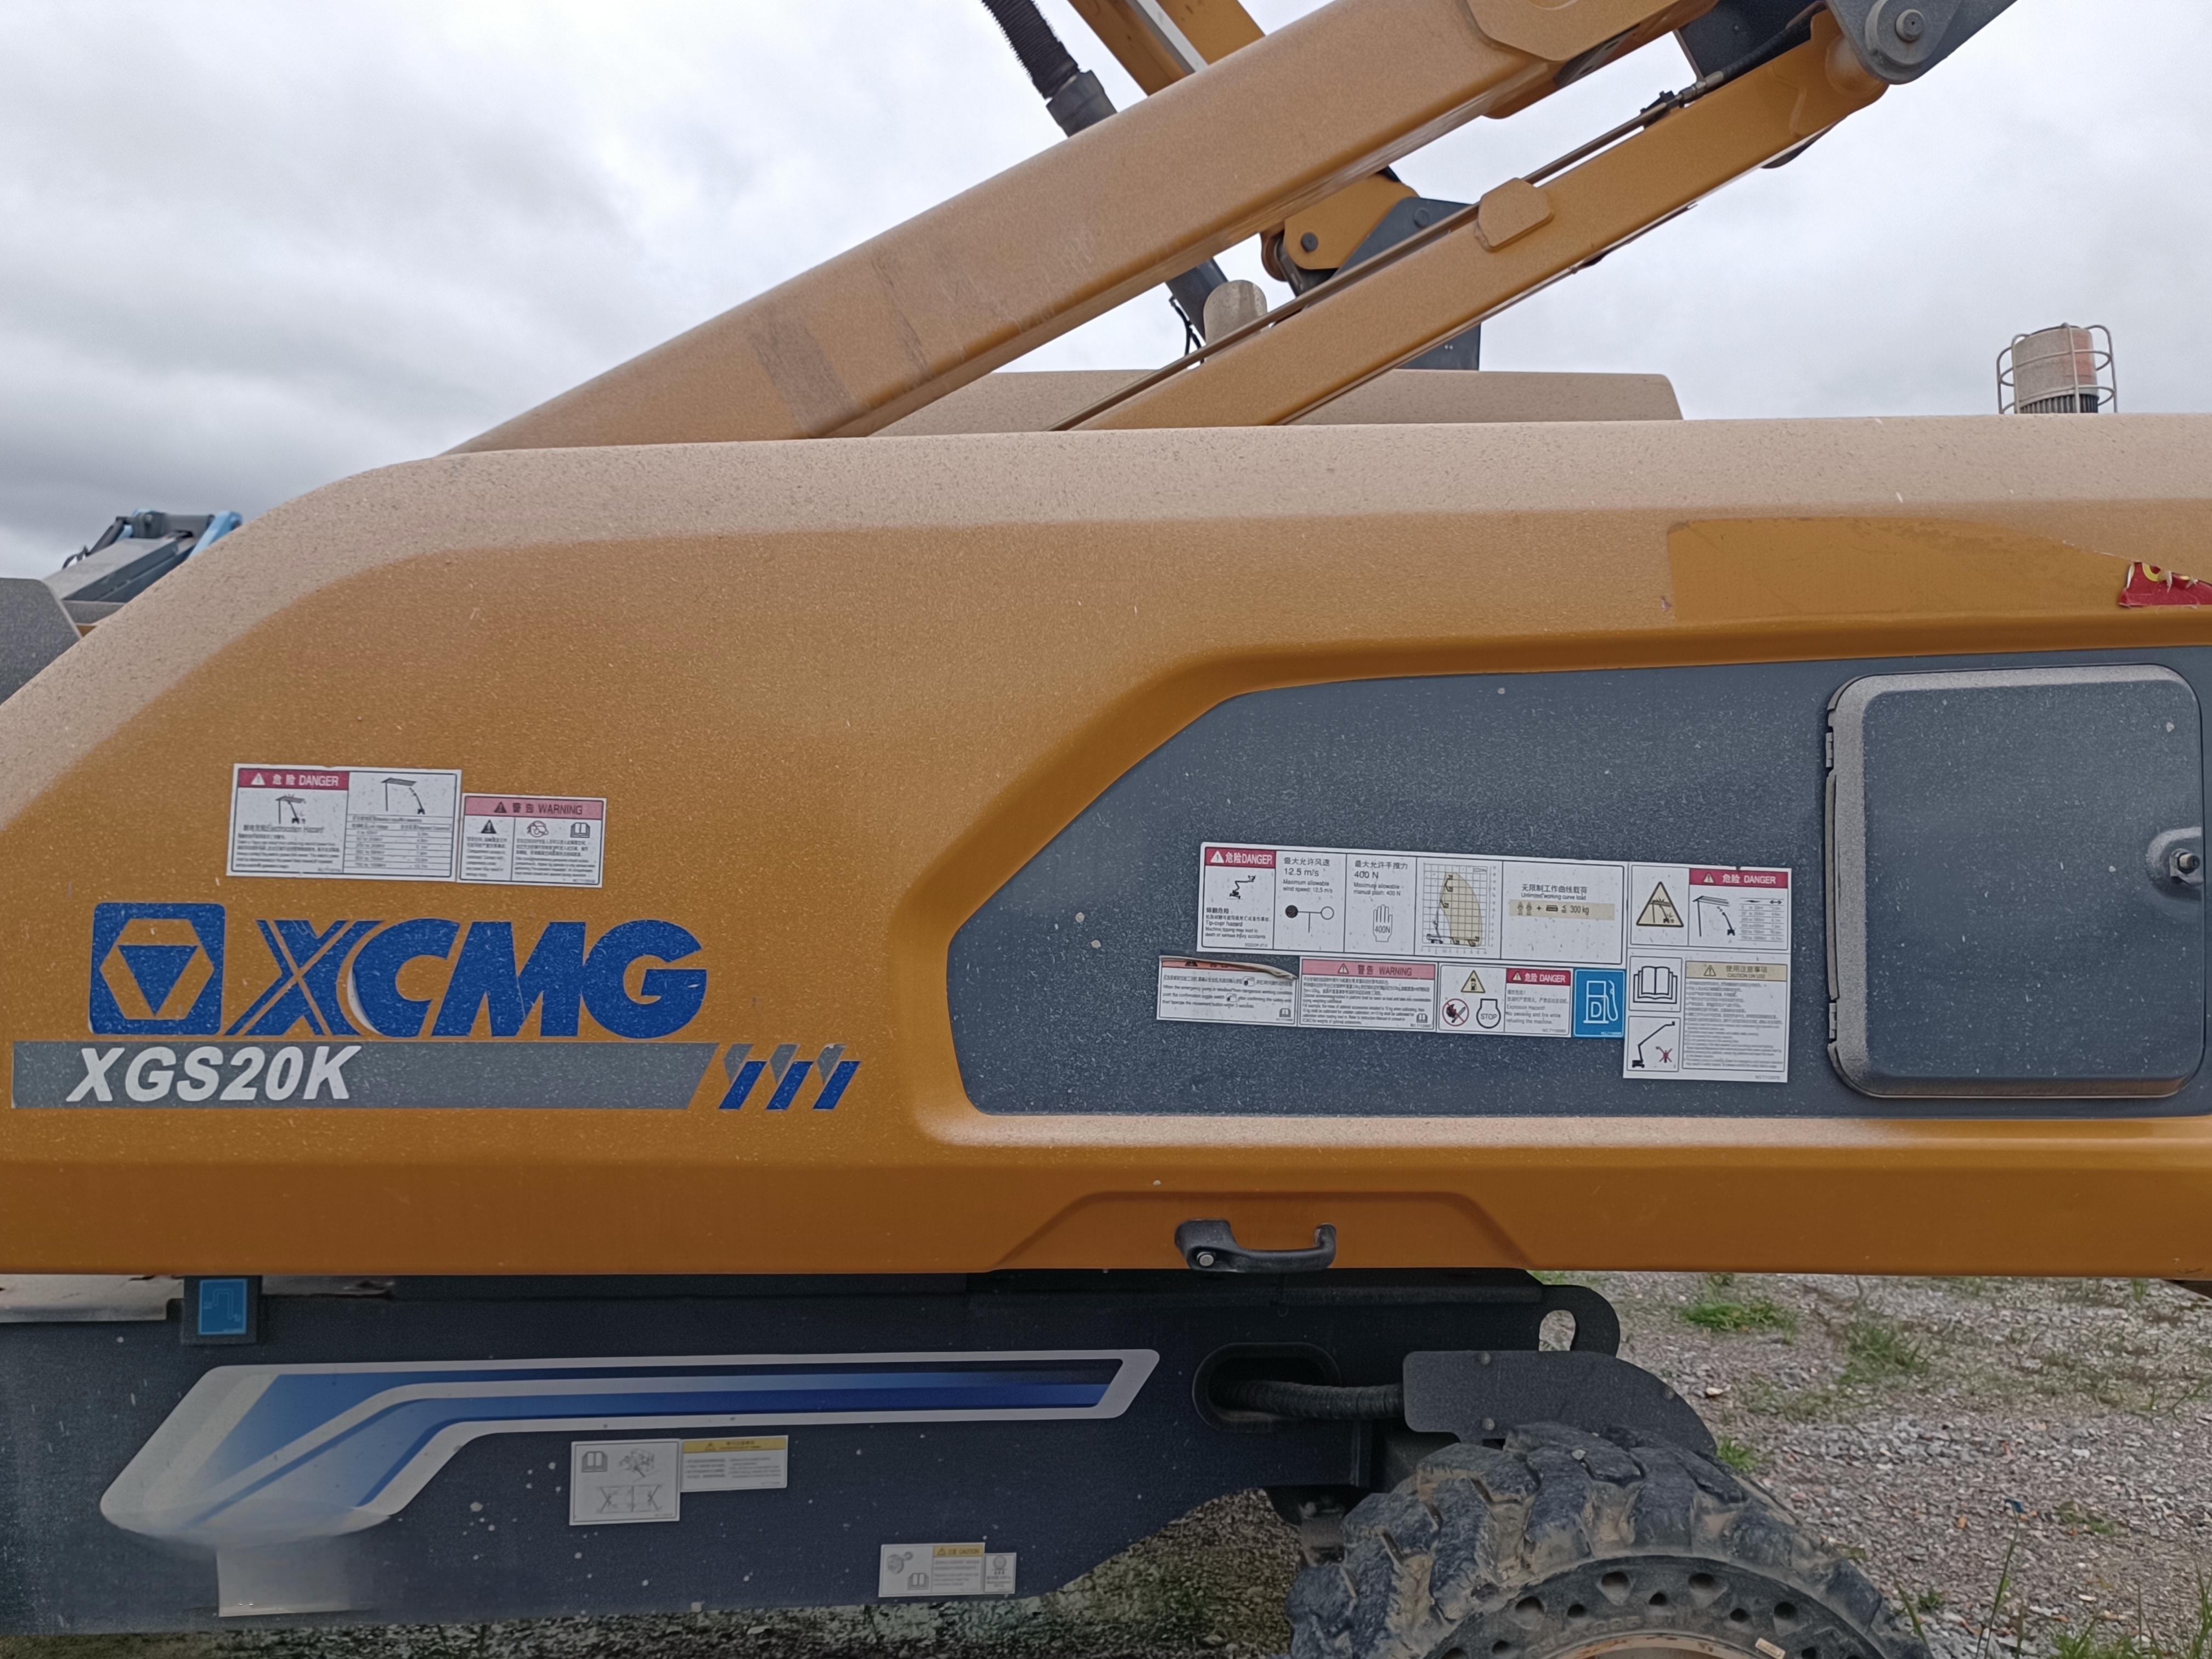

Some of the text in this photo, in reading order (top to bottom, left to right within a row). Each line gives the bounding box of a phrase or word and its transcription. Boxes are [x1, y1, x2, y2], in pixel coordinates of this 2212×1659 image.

[298, 775, 339, 786] DANGER
[539, 804, 583, 815] WARNING
[1225, 852, 1272, 865] 危险 DANGER
[1284, 857, 1330, 866] 最大允许风速
[1723, 873, 1776, 884] 危险 DANGER
[1582, 906, 1589, 915] kg
[1379, 966, 1412, 976] WARNING
[224, 918, 707, 1039] XCMG
[1539, 974, 1565, 983] DANGER
[66, 1046, 362, 1102] XGS20K
